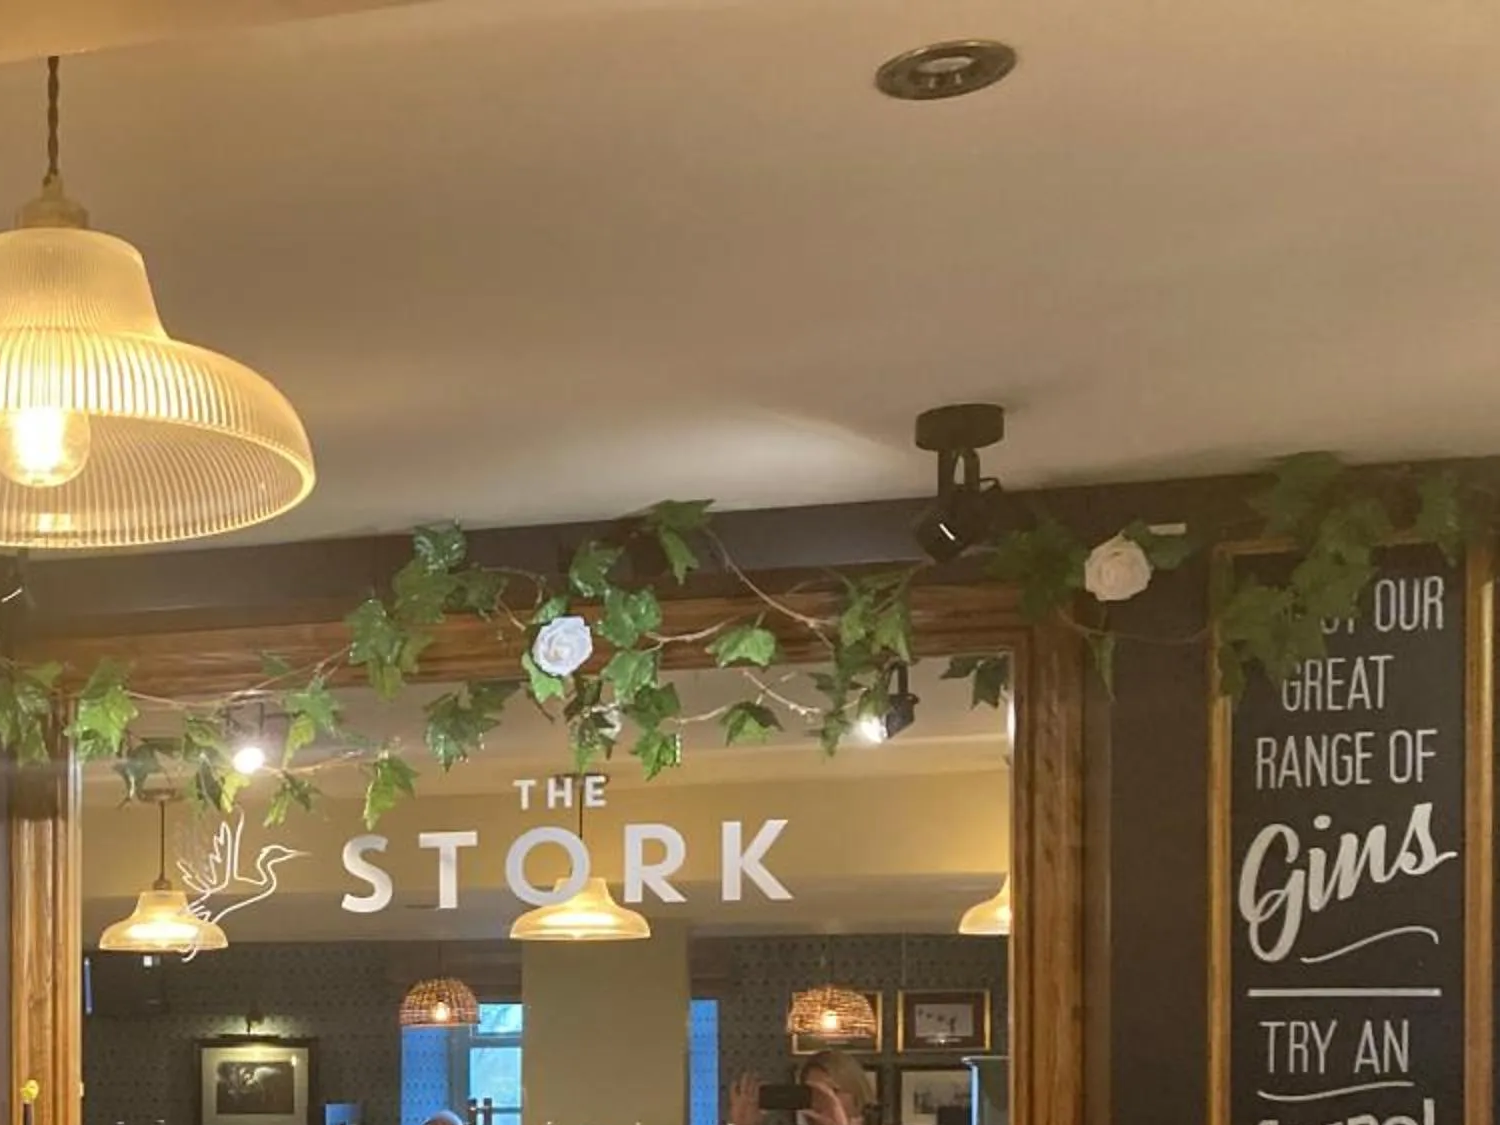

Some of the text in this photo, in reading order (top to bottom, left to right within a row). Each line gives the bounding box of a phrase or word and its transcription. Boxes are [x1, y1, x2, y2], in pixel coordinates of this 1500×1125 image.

[1373, 576, 1445, 632] OUR
[1281, 655, 1394, 712] GREAT
[1256, 728, 1438, 789] RANGE OF
[513, 775, 607, 810] THE
[341, 818, 795, 914] STORK
[1238, 803, 1458, 962] Gins
[1259, 1019, 1410, 1075] TRY AN
